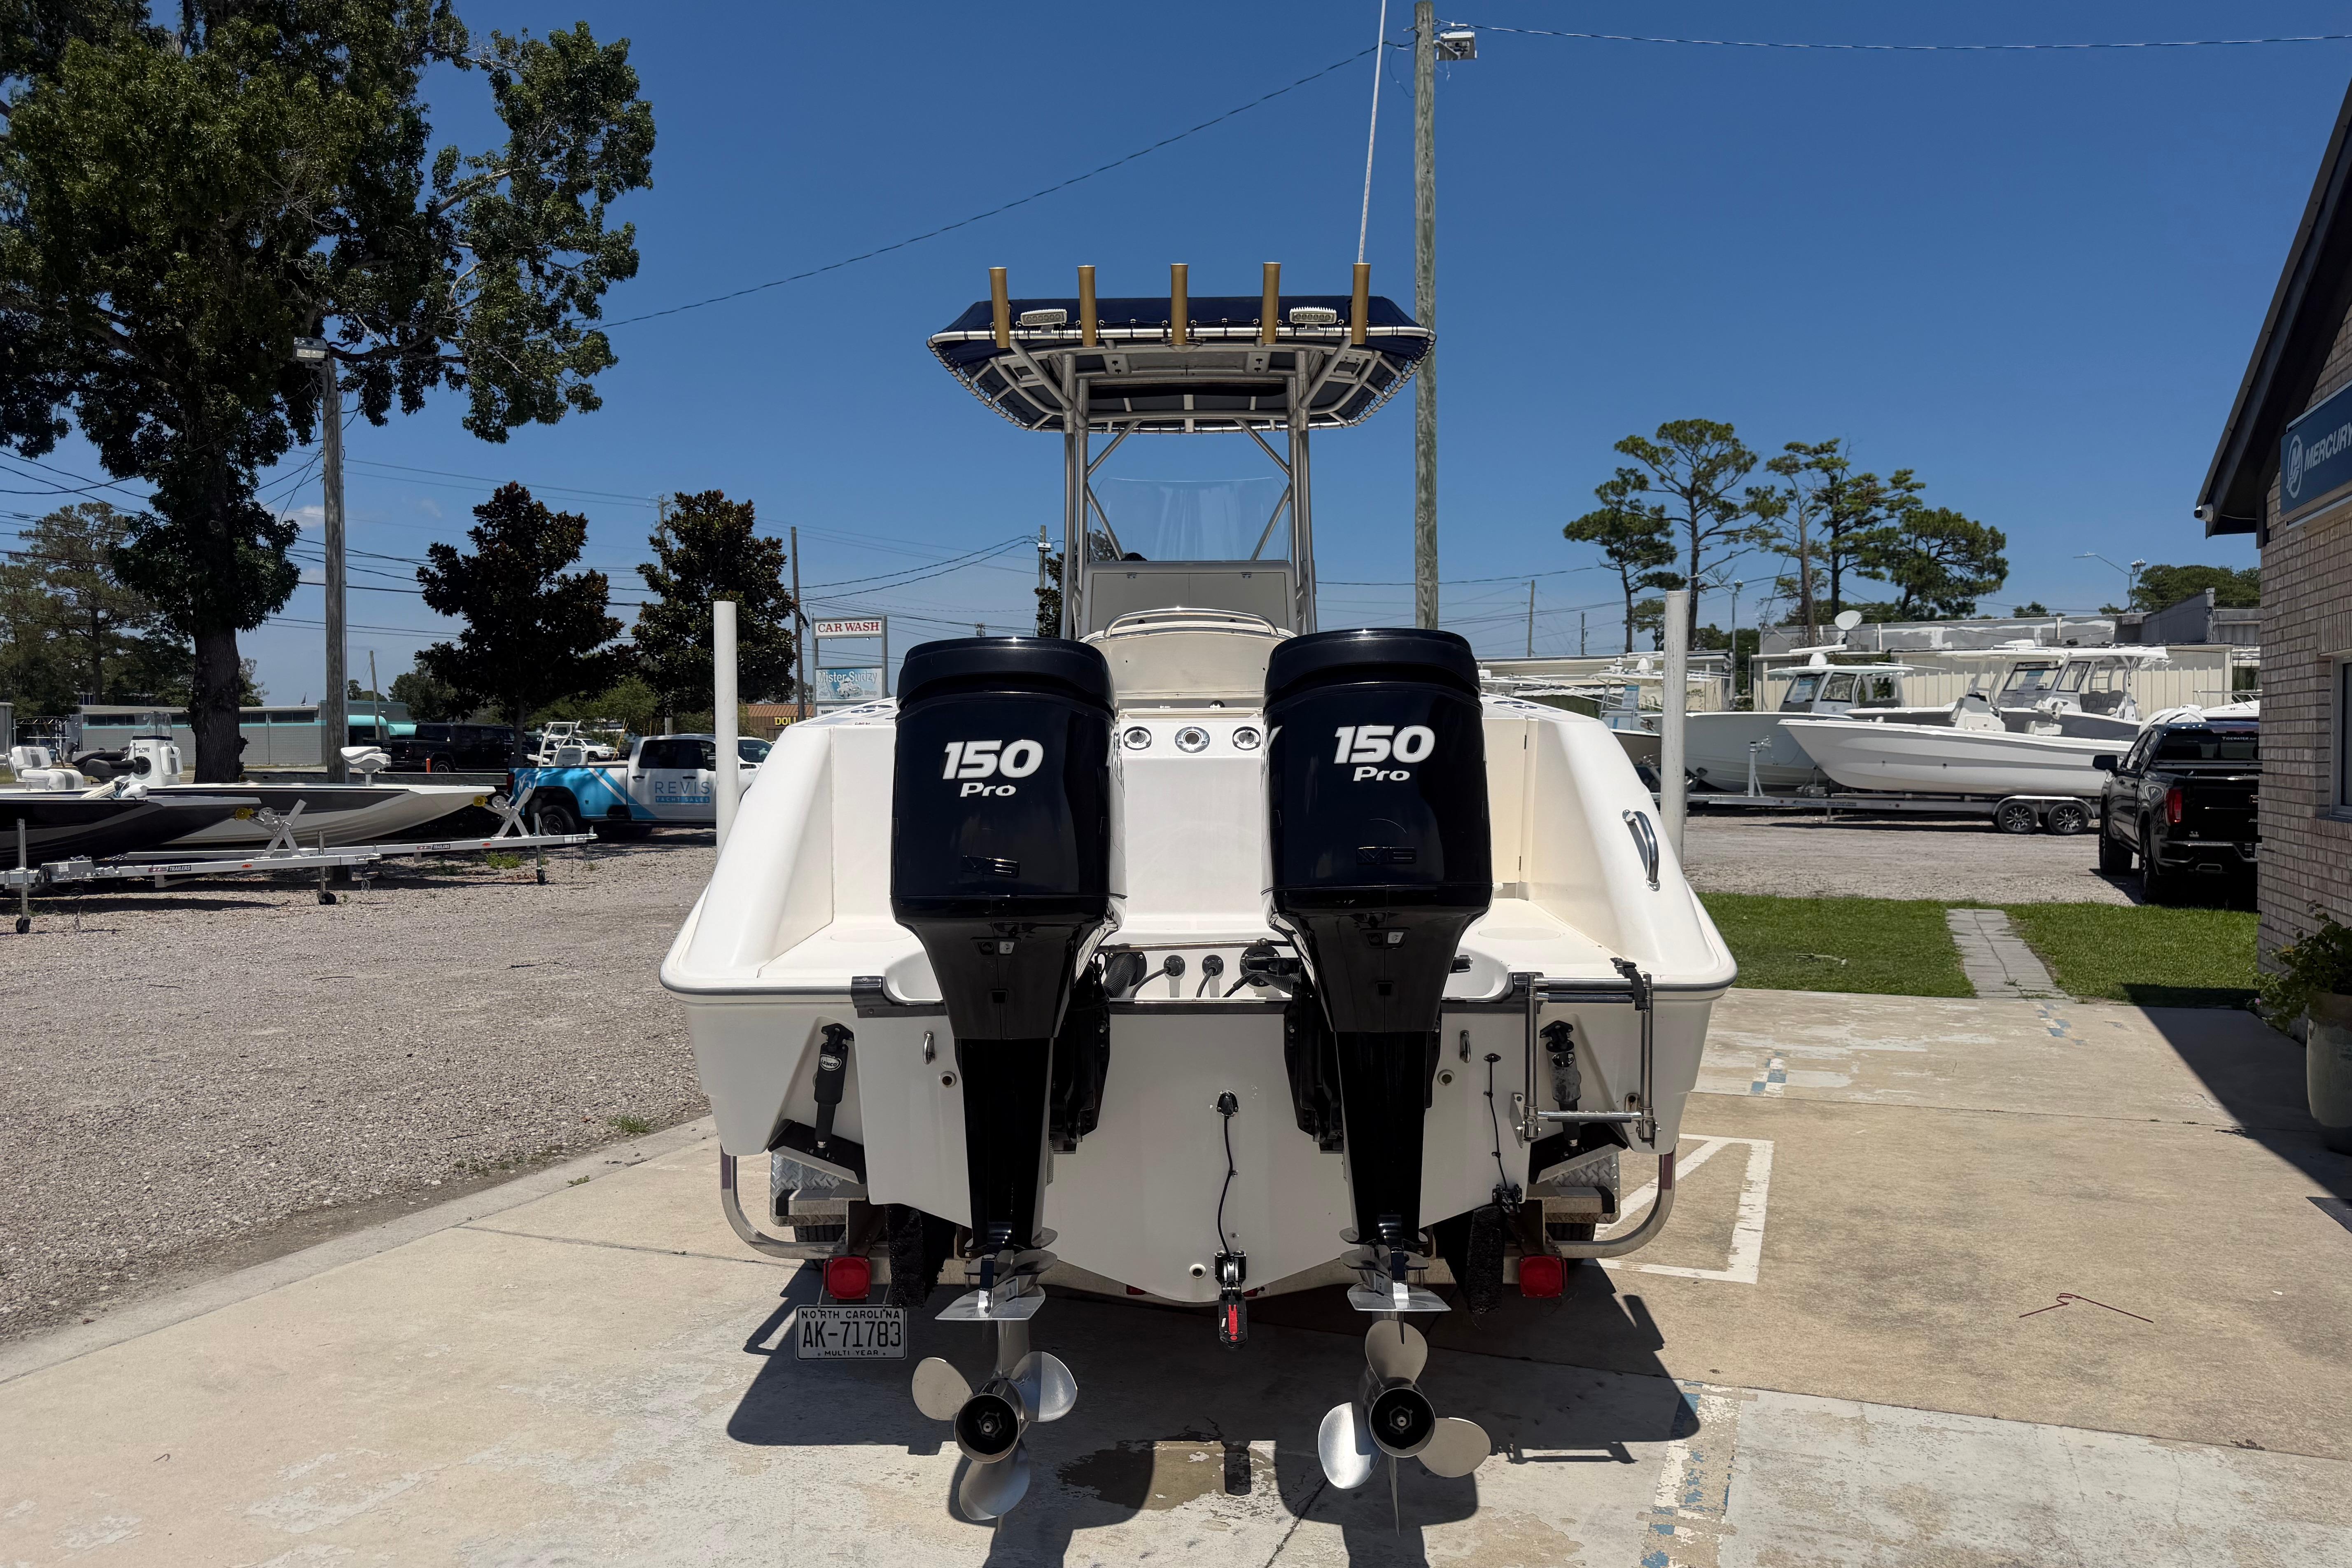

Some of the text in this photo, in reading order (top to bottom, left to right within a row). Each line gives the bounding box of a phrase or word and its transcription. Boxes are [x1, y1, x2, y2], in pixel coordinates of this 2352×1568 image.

[2304, 422, 2352, 472] MERCURY
[818, 622, 880, 632] CAR WASH
[819, 670, 877, 685] Mister Sudzy
[1334, 726, 1435, 764] 150
[943, 740, 1044, 779] 150
[1353, 766, 1410, 781] Pro
[655, 782, 710, 794] REVIS
[960, 782, 1017, 797] Pro
[801, 1310, 900, 1319] NORTH CAROLINA
[803, 1321, 901, 1348] AK-71783
